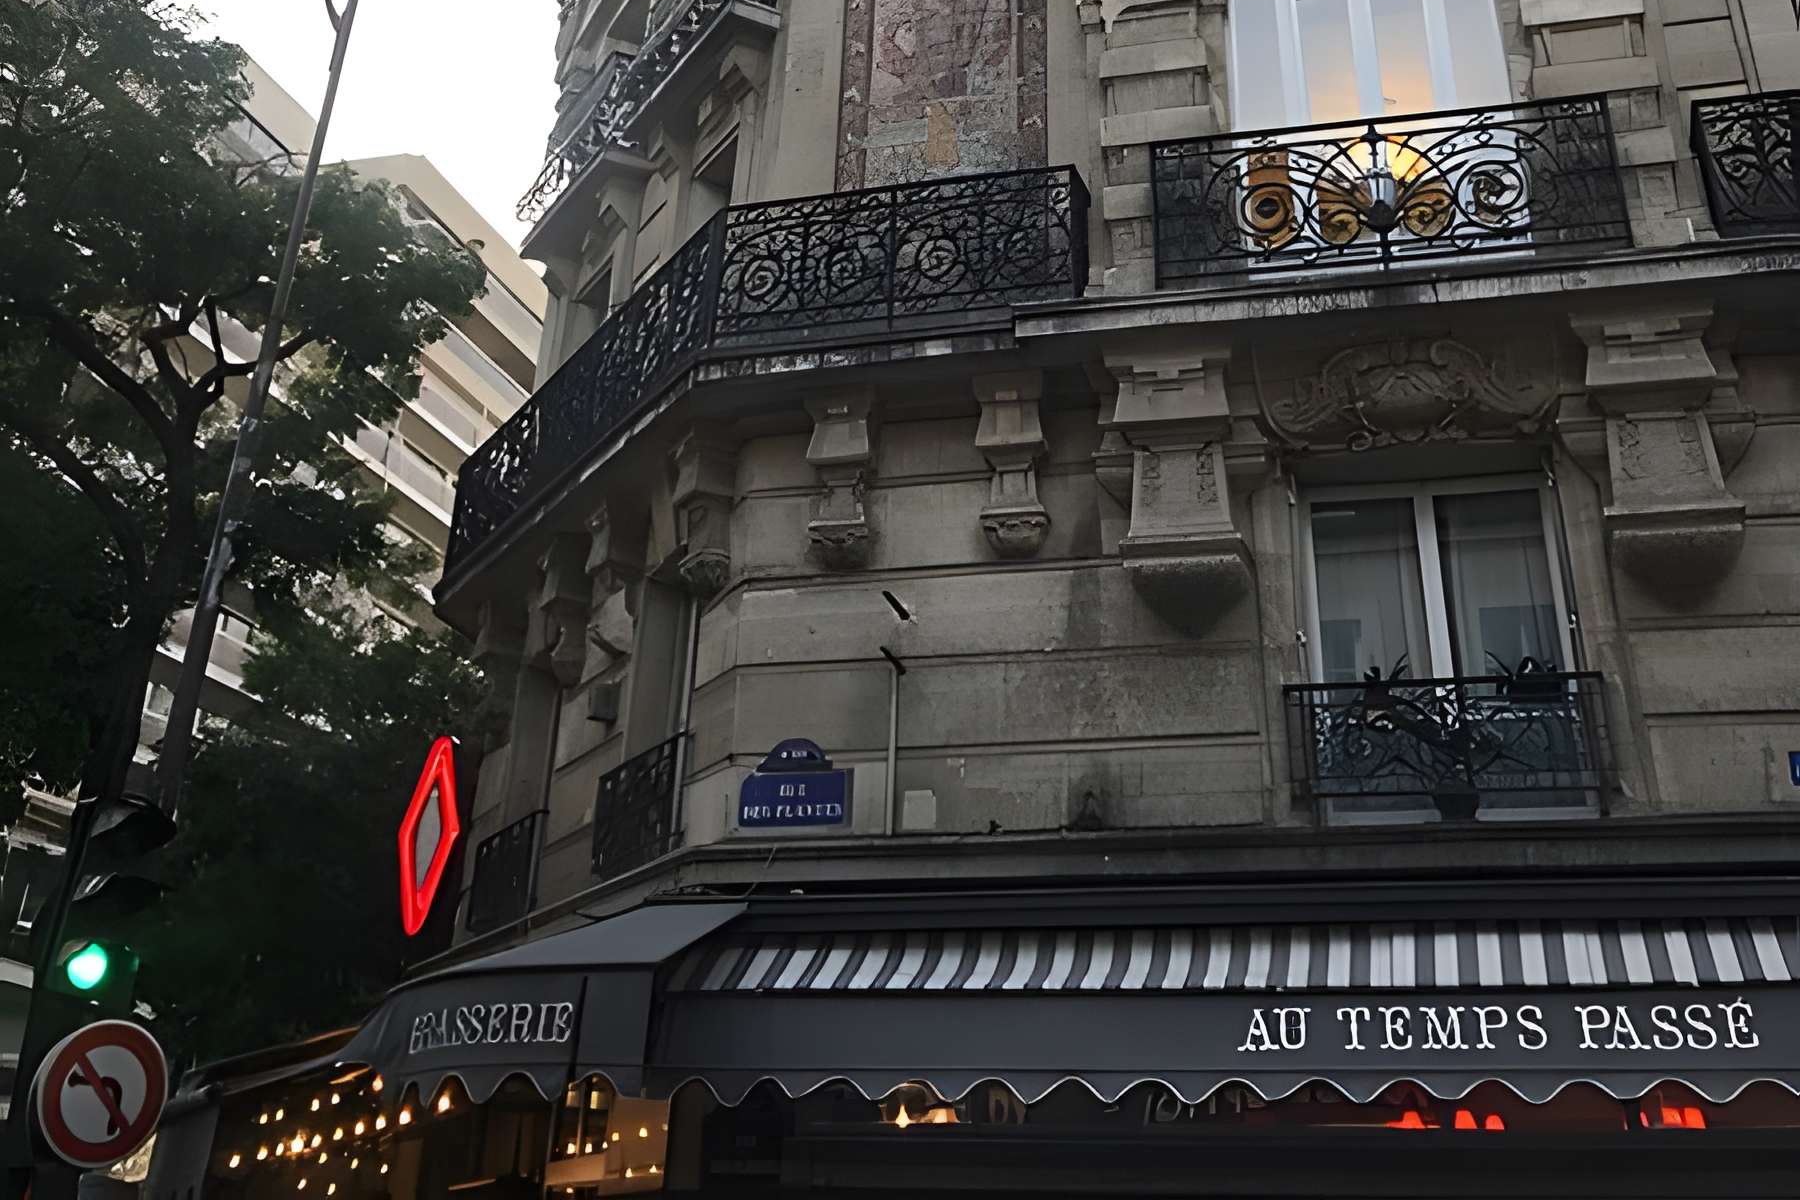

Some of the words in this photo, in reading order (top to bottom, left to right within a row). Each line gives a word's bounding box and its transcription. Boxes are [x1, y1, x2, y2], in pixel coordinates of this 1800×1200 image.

[407, 1001, 574, 1055] BRASSERIE
[1237, 1007, 1311, 1052] AU
[1336, 1004, 1549, 1050] TEMPS
[1574, 996, 1760, 1050] PASSÉ
